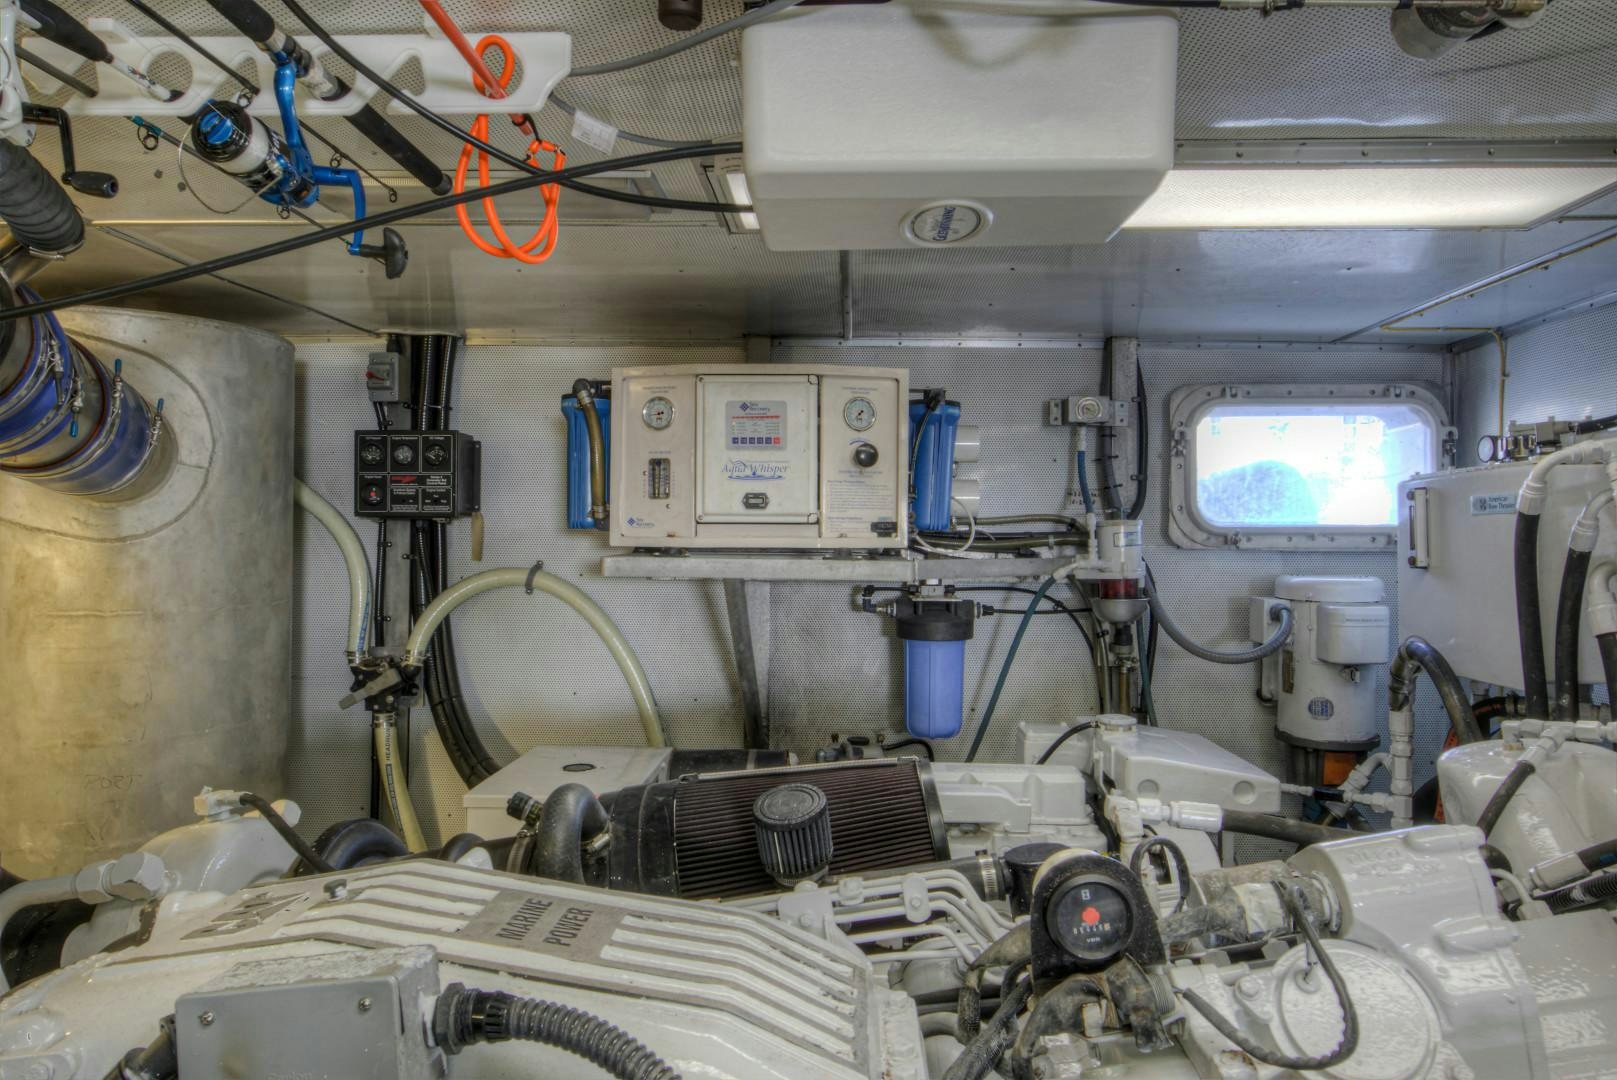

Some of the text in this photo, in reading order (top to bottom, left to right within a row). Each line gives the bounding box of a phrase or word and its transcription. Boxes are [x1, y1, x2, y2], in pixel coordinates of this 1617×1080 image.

[749, 461, 789, 476] Whisper
[85, 774, 143, 791] PORT
[496, 898, 553, 941] MARINE
[543, 906, 595, 947] POWER
